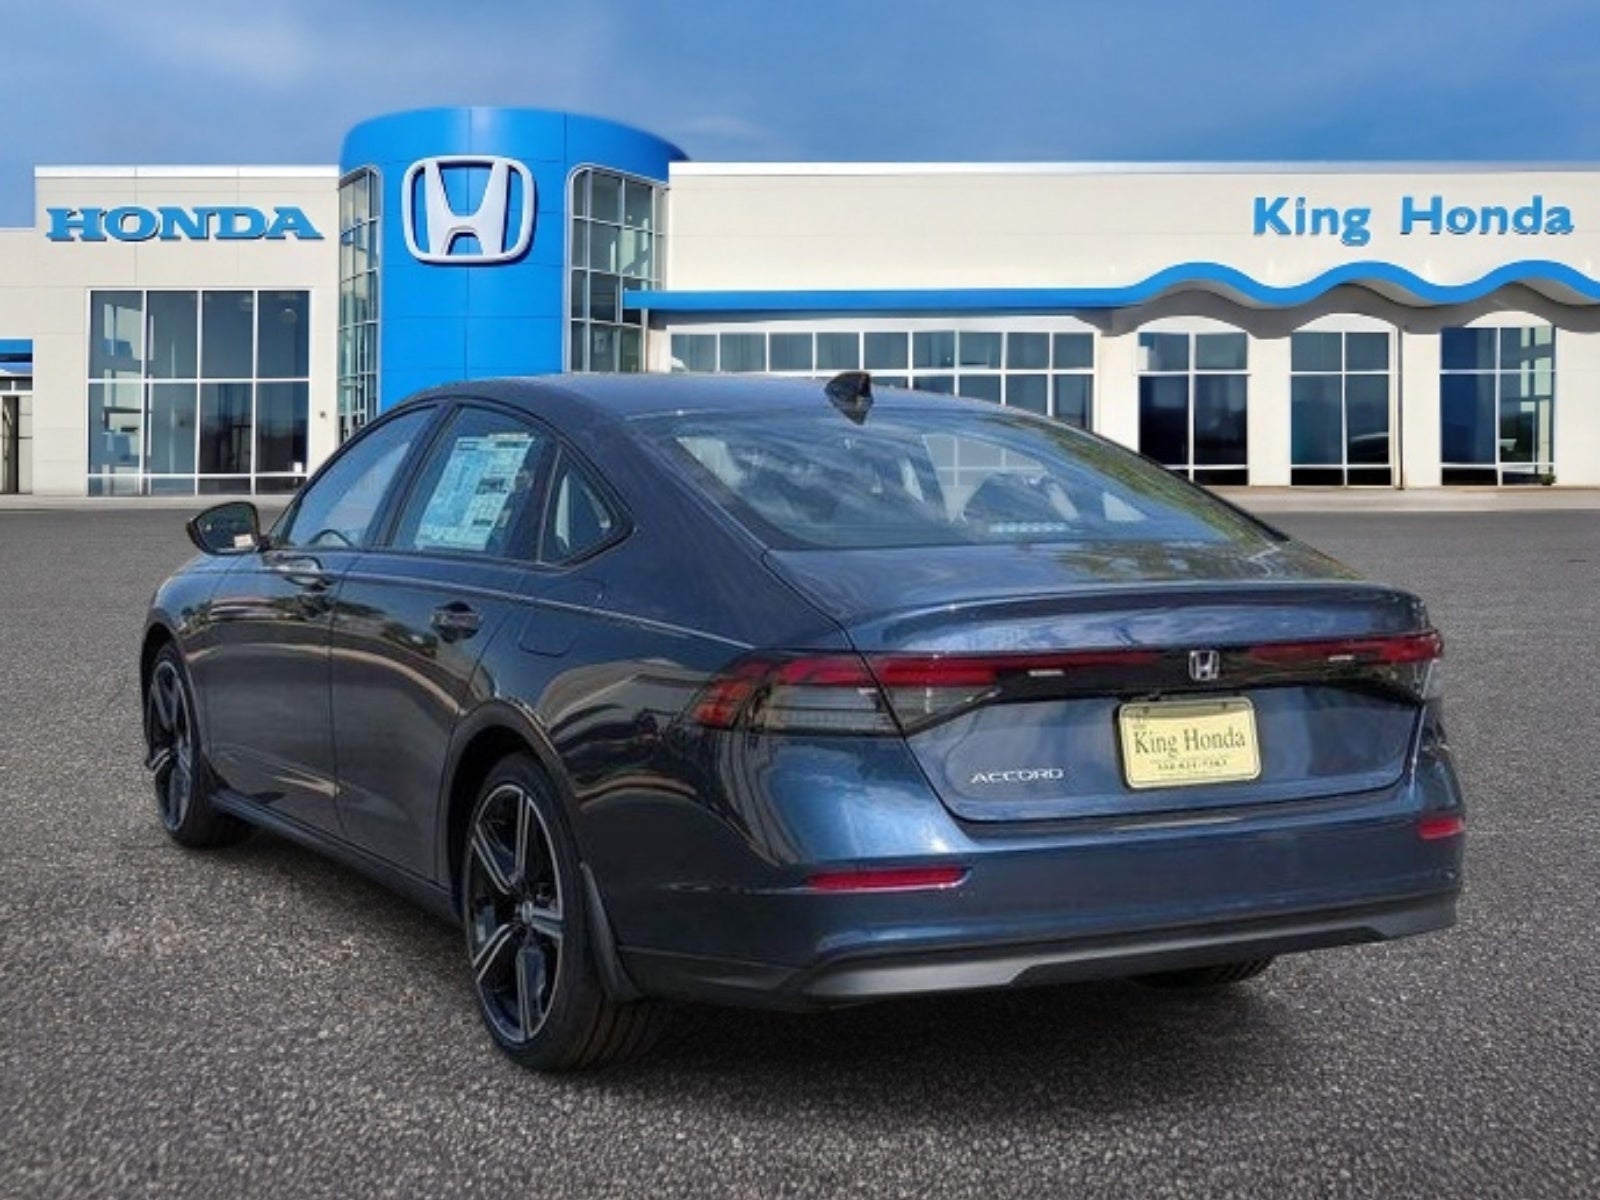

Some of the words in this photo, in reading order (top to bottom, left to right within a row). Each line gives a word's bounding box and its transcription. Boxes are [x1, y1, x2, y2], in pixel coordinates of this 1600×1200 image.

[45, 206, 325, 242] HONDA
[1252, 196, 1371, 247] King
[1399, 195, 1575, 236] Honda
[1133, 730, 1178, 758] King
[1183, 726, 1246, 751] Honda
[970, 767, 1064, 784] ACCORD
